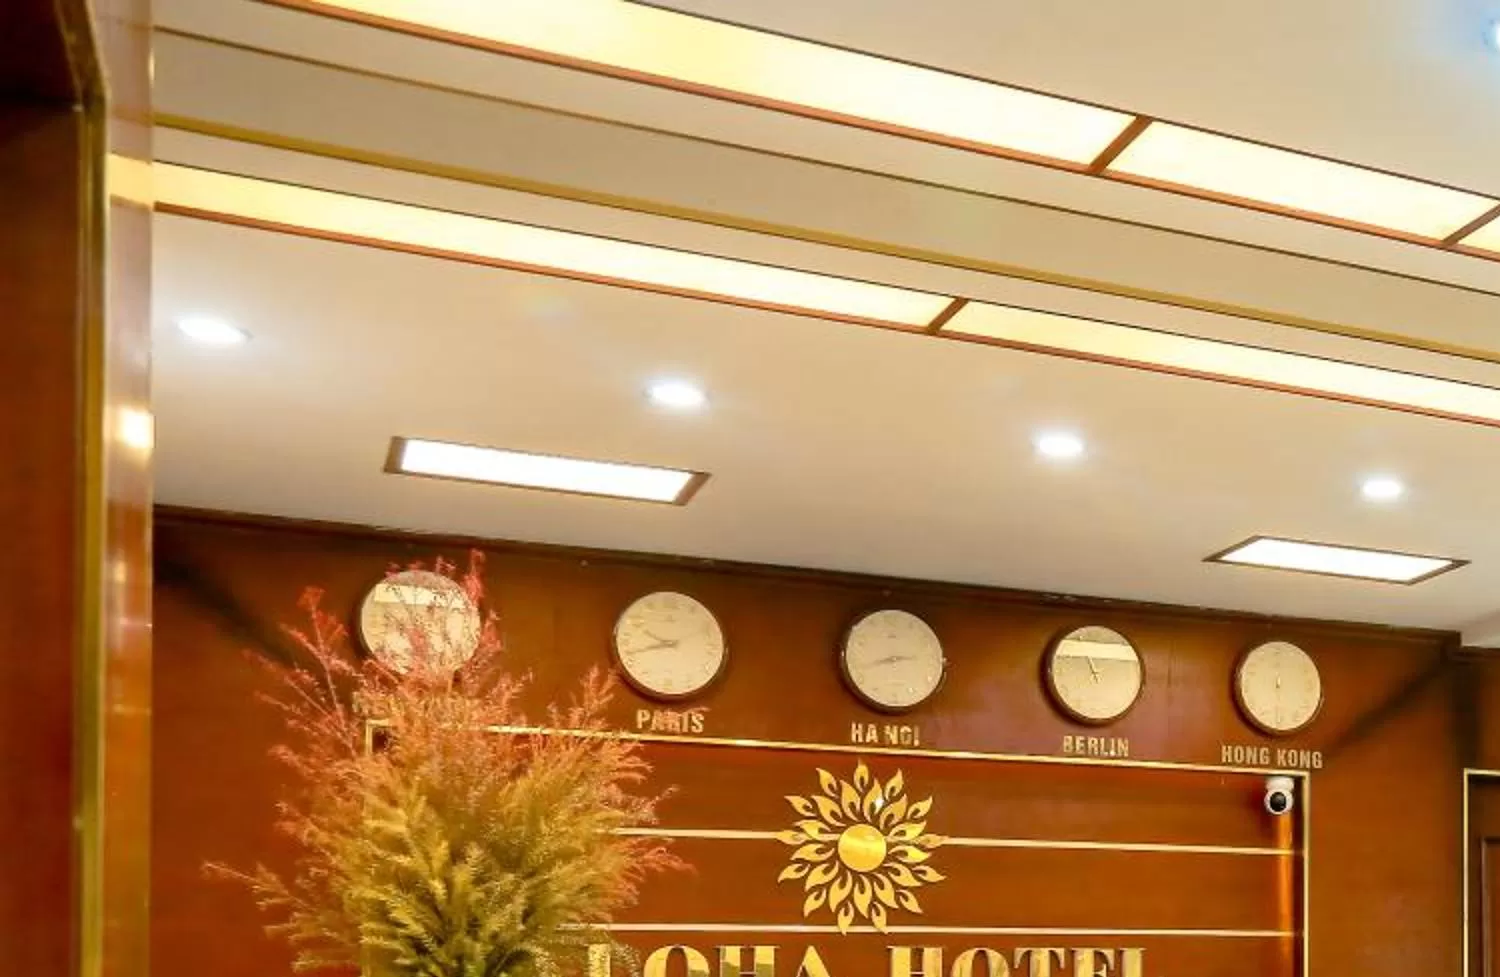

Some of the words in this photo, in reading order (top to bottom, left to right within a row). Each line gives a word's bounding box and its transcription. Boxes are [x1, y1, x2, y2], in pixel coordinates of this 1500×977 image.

[636, 708, 705, 734] PARIS
[851, 721, 879, 744] HA
[1062, 735, 1130, 758] BERLIN
[1221, 744, 1271, 767] HONG
[1277, 747, 1324, 770] KONG
